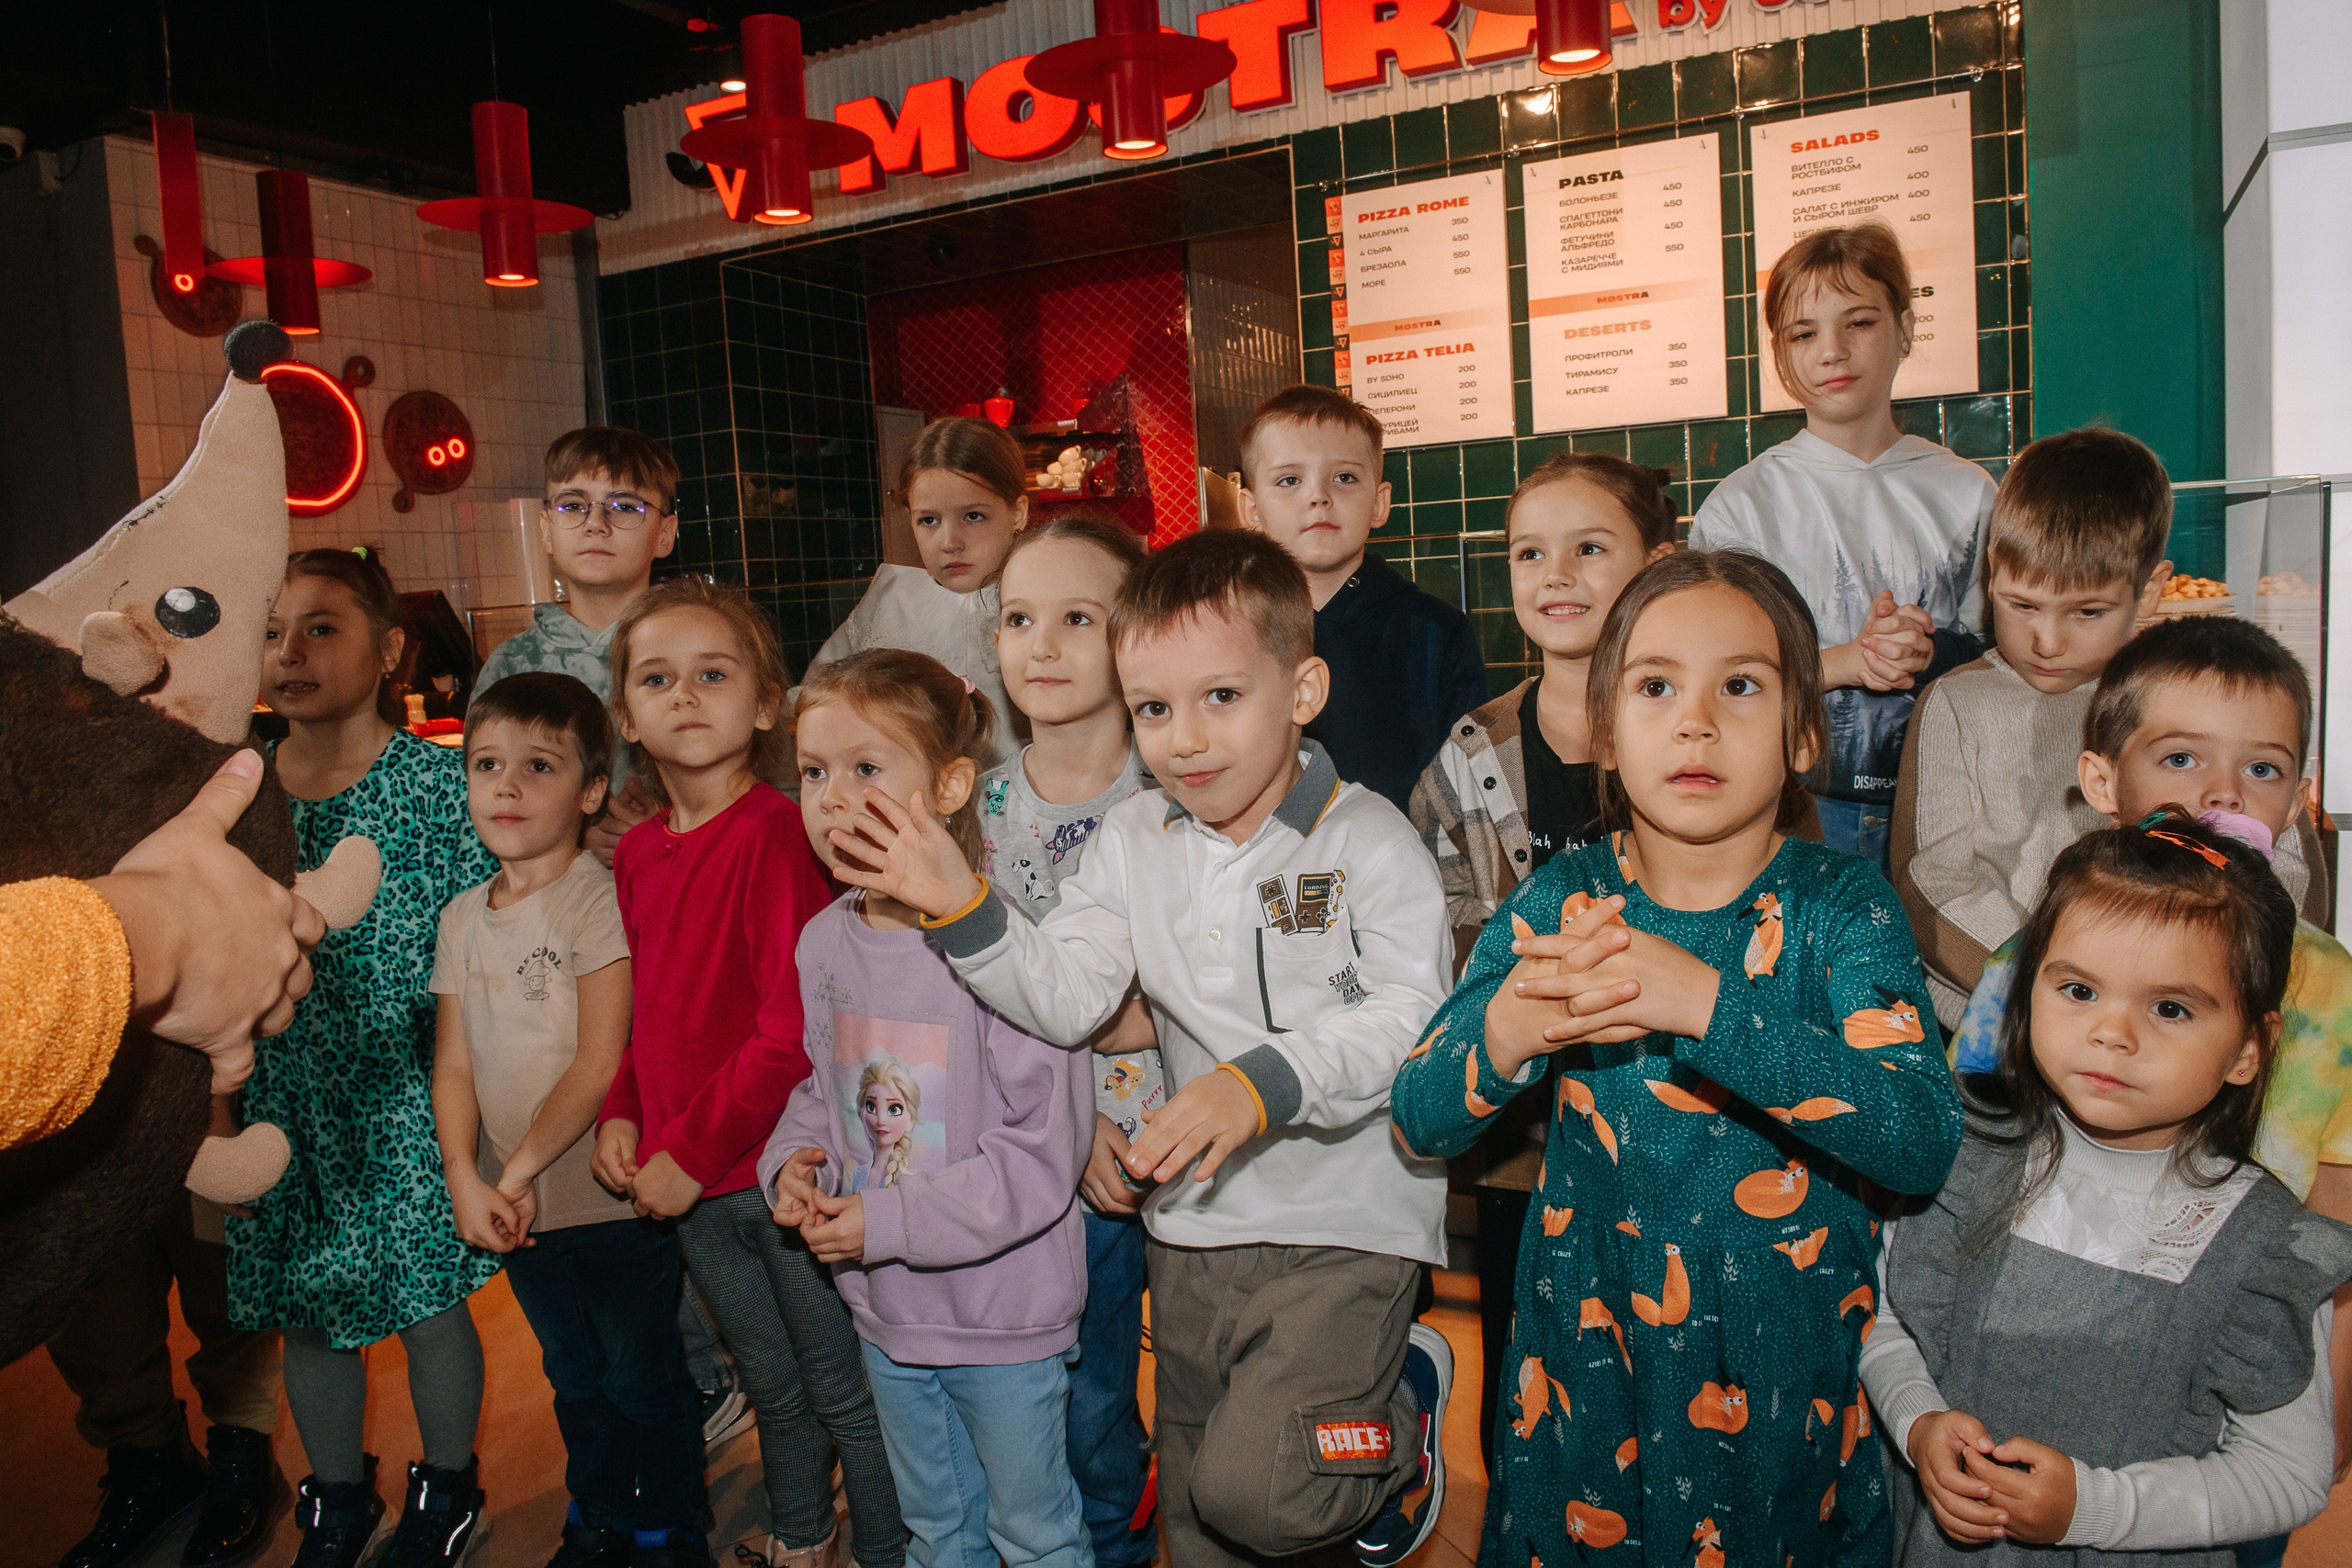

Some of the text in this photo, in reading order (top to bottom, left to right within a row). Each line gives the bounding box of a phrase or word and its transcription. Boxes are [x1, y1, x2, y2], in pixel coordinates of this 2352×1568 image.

[834, 0, 1636, 195] MOTR
[1791, 130, 1880, 153] SALADS
[1907, 145, 1928, 154] 450
[1792, 158, 1843, 173] ВИТЕЛЛО
[1792, 163, 1861, 180] РОСТБИФОМ
[1559, 170, 1623, 189] PASTA
[1907, 171, 1929, 180] 400
[1663, 183, 1682, 191] 450
[1792, 184, 1841, 197] КАПРЕЗЕ
[1908, 189, 1930, 198] 400
[1559, 192, 1618, 207] БОЛОНЬЕЗЕ
[1664, 199, 1682, 208] 450
[1792, 203, 1827, 215] САЛАТ
[1841, 194, 1899, 209] ИНЖИРОМ
[1358, 197, 1469, 223] PIZZA ROME
[1560, 208, 1623, 223] СПАГЕТТОНИ
[1804, 209, 1845, 221] СЫРОМ
[1849, 205, 1879, 216] ШЕВР
[1452, 217, 1468, 225] 350
[1560, 217, 1618, 231] КАРБОНАРА
[1910, 213, 1931, 222] 450
[1664, 221, 1683, 230] 450
[1359, 226, 1409, 241] МАРГАРИТА
[1452, 233, 1469, 242] 450
[1560, 231, 1613, 244] ФЕТУЧИНИ
[1367, 245, 1392, 255] СЫРА
[1561, 239, 1615, 253] АЛЬФРЕДО
[1665, 243, 1684, 252] 550
[1453, 250, 1470, 258] 550
[1562, 253, 1617, 266] КАЗАРЕЧЧЕ
[1361, 260, 1407, 273] БРЕЗАОЛА
[1453, 266, 1471, 276] 550
[1571, 259, 1623, 272] МИДИЯМИ
[1362, 279, 1386, 288] МОРЕ
[1597, 291, 1649, 304] MOSTRA
[1394, 320, 1442, 332] MOSTRA
[1564, 320, 1652, 340] DESERTS
[1668, 343, 1687, 351] 350
[1366, 343, 1476, 365] PIZZA TELIA
[1565, 349, 1634, 362] ПРОФИТРОЛИ
[1458, 365, 1476, 373] 200
[1668, 360, 1688, 368] 350
[1381, 373, 1404, 382] SOHO
[1566, 367, 1619, 379] ТИРАМИСУ
[1669, 378, 1688, 386] 350
[1368, 388, 1418, 400] СИЦИЛИЕЦ
[1566, 386, 1610, 396] КАПРЕЗЕ
[1460, 397, 1477, 405] 200
[1382, 418, 1419, 429] УРИЦЕЙ
[1382, 426, 1419, 435] РИБАМИ
[1854, 775, 1897, 790] DISAPPEA
[532, 947, 562, 969] COOL
[1329, 961, 1355, 986] START
[1334, 971, 1357, 992] YOUR
[1343, 983, 1360, 998] DAY
[1317, 1427, 1385, 1453] RACE
